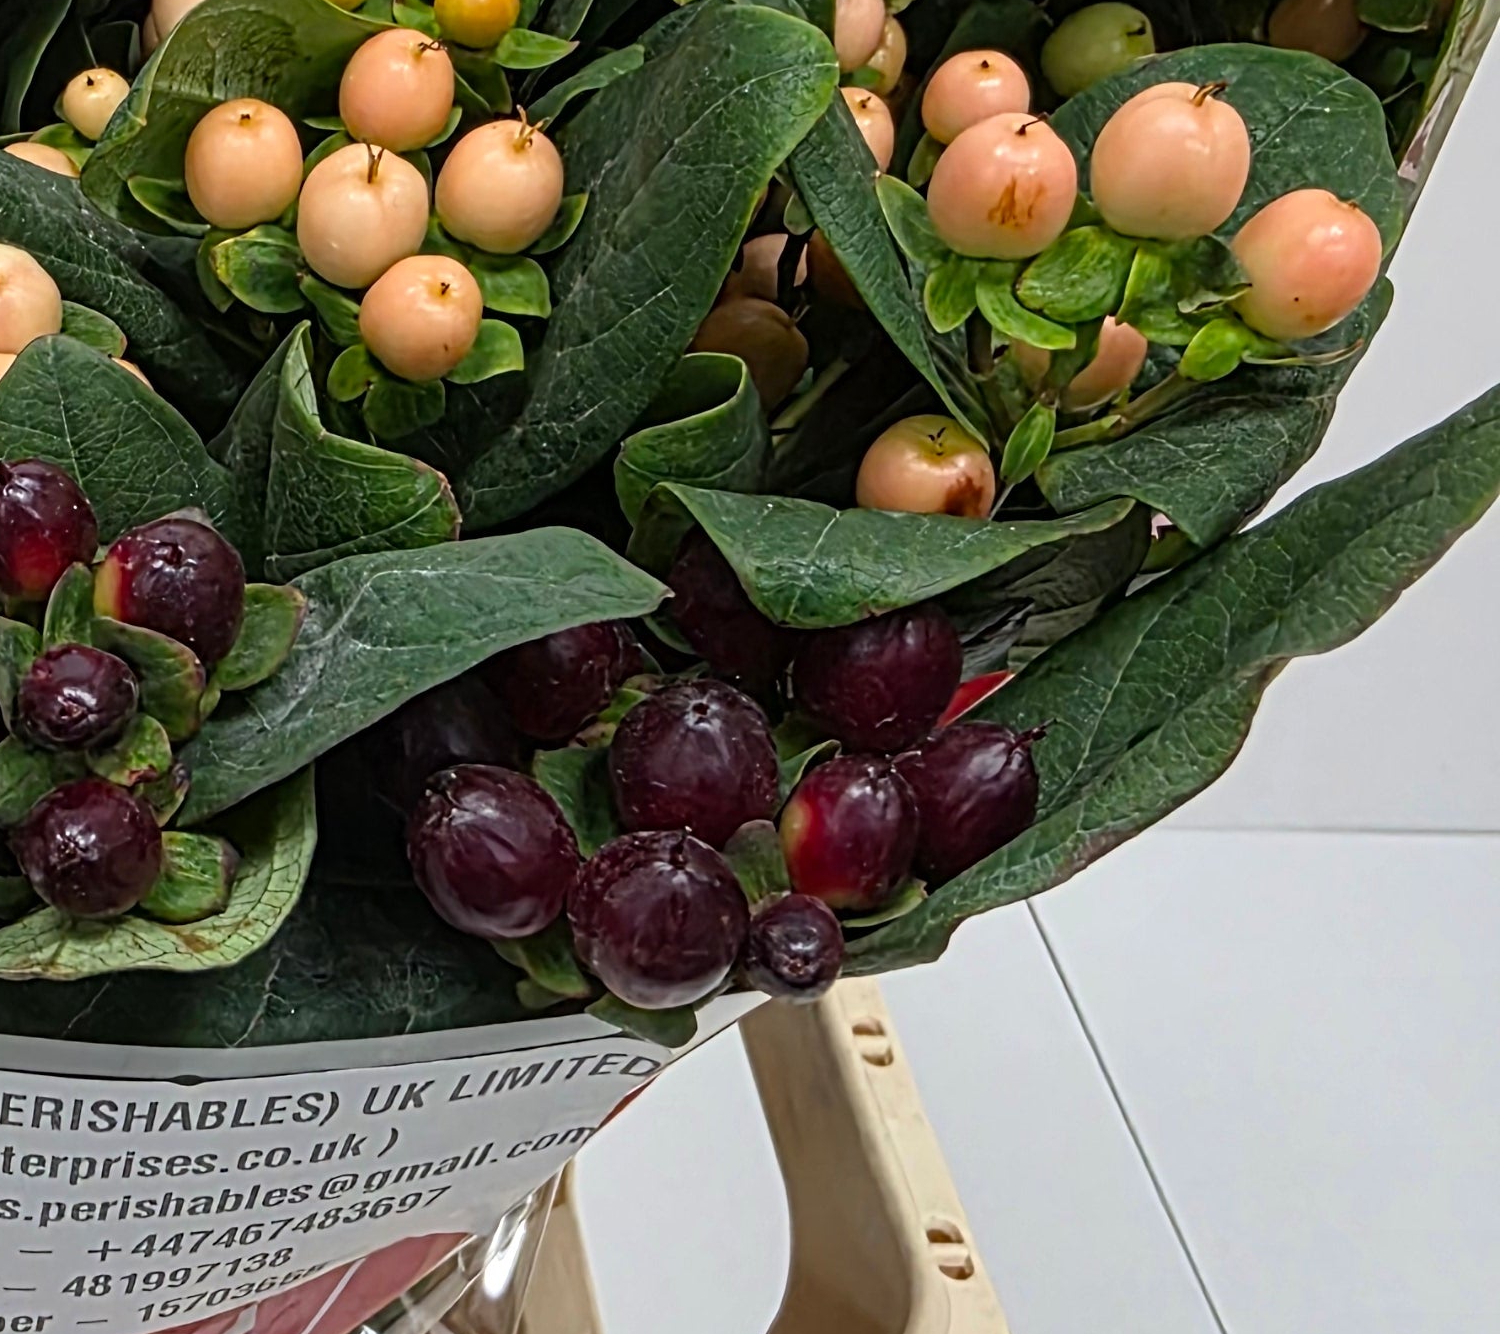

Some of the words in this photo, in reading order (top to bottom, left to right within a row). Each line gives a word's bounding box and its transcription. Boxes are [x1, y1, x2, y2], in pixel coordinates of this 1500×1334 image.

[362, 1079, 435, 1115] UK
[449, 1053, 662, 1101] LIMITED
[87, 1185, 452, 1262] +447467483697
[62, 1246, 294, 1298] 481997138
